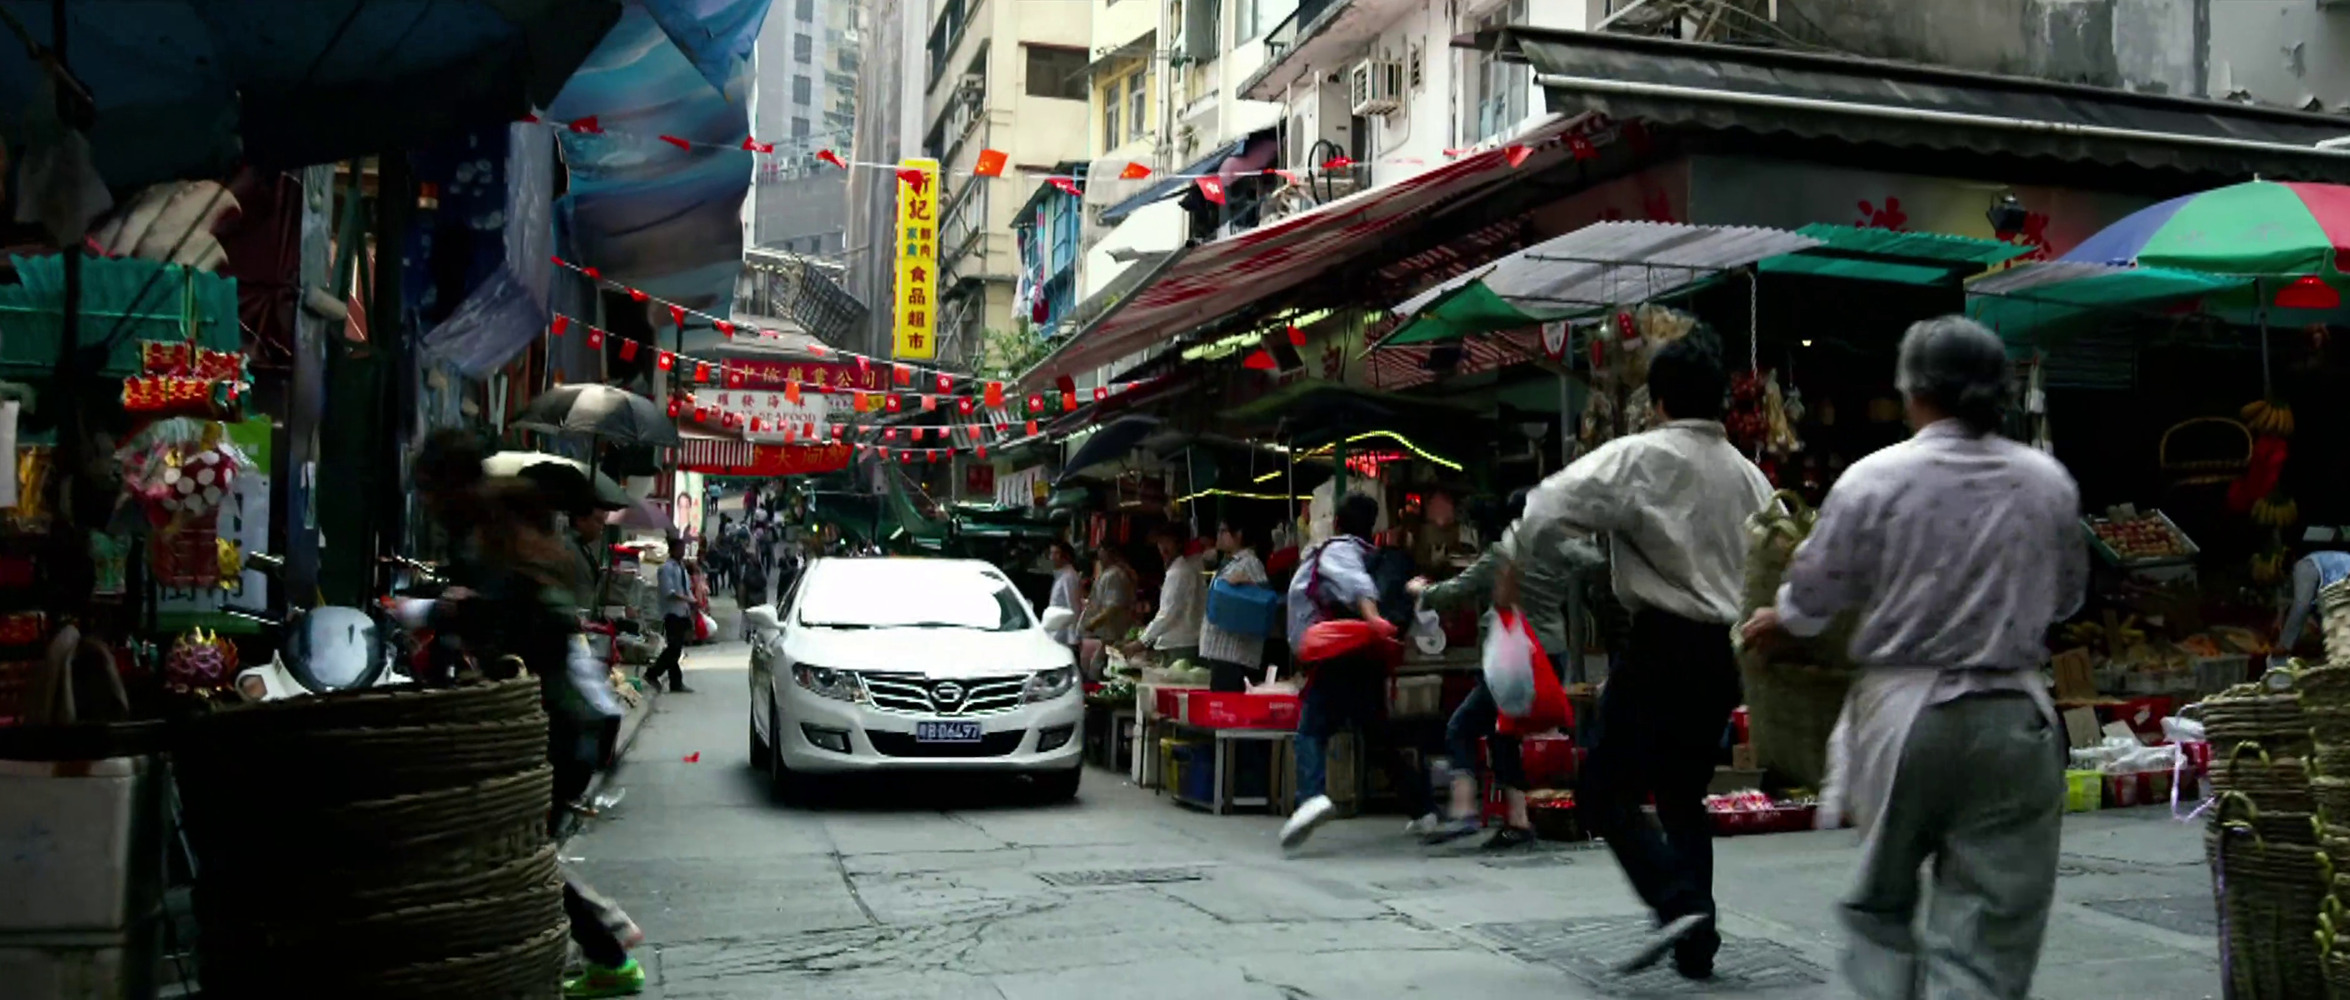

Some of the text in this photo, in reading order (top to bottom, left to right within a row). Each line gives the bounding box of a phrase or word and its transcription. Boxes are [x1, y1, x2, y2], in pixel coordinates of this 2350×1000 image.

[908, 265, 926, 350] 食品超市
[759, 411, 816, 422] SEAFOOD
